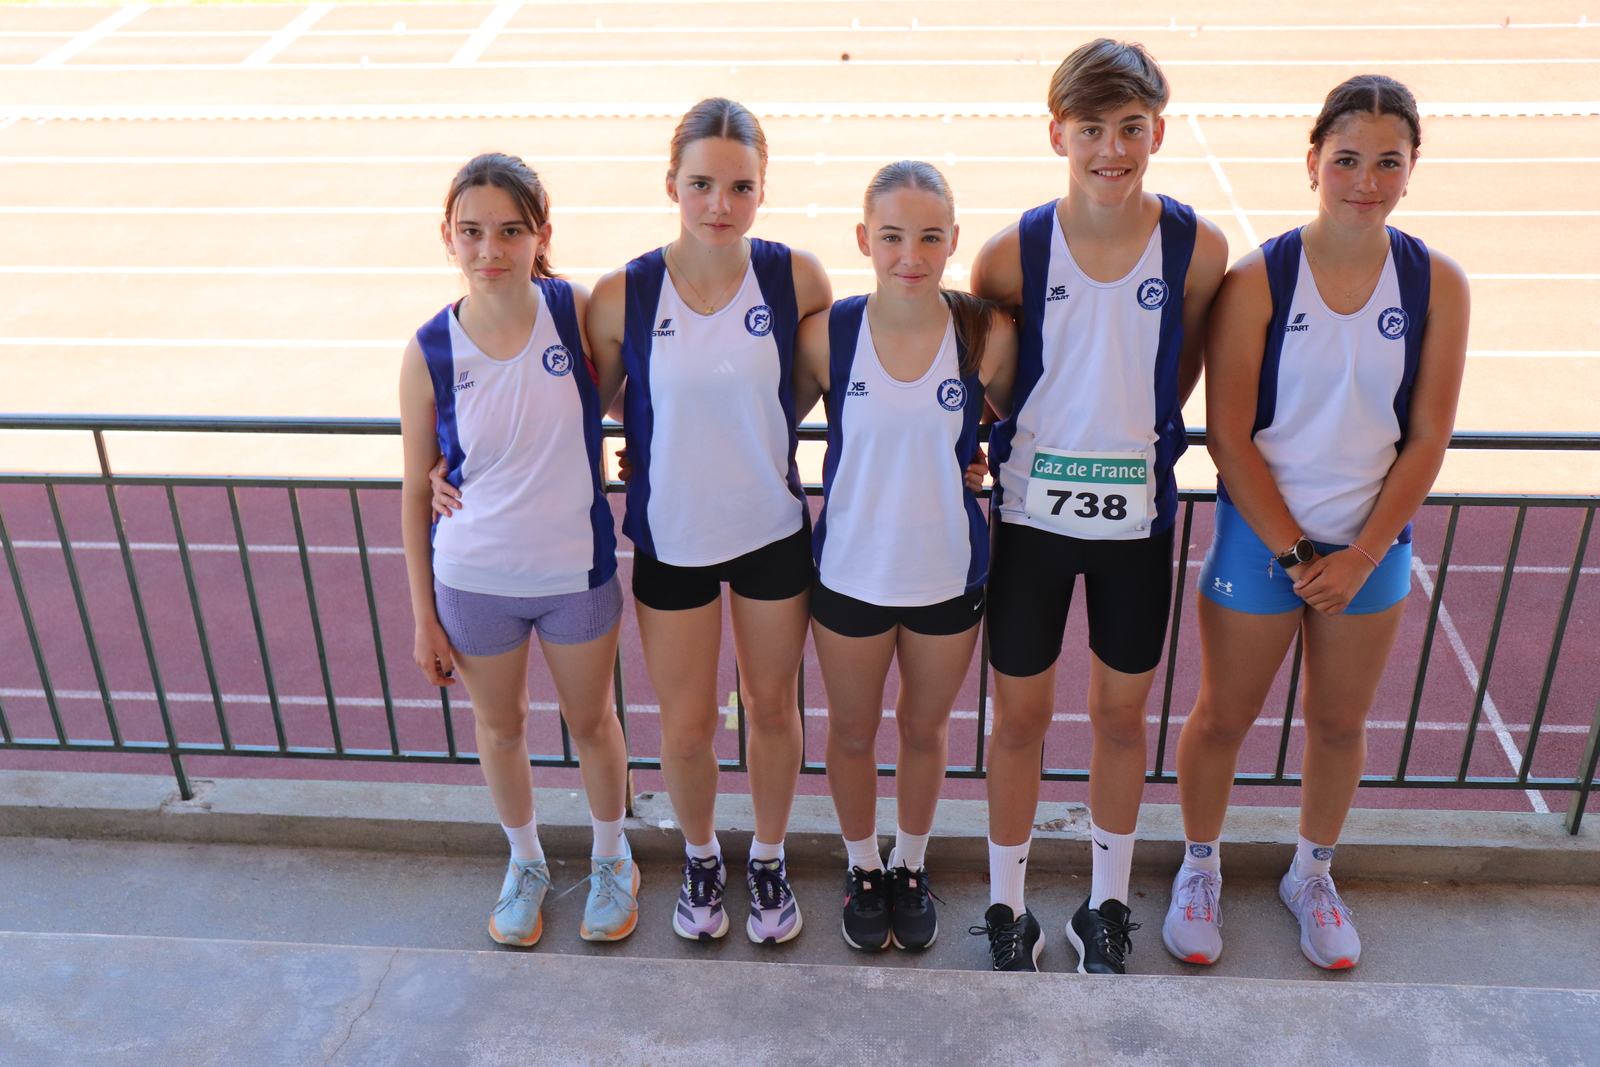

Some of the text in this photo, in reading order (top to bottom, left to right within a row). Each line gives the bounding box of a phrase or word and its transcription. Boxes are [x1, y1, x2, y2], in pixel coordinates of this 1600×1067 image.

[1047, 294, 1069, 302] START
[1285, 324, 1309, 332] START
[452, 381, 474, 393] START
[1034, 459, 1145, 478] Gaz de France
[1047, 489, 1127, 521] 738
